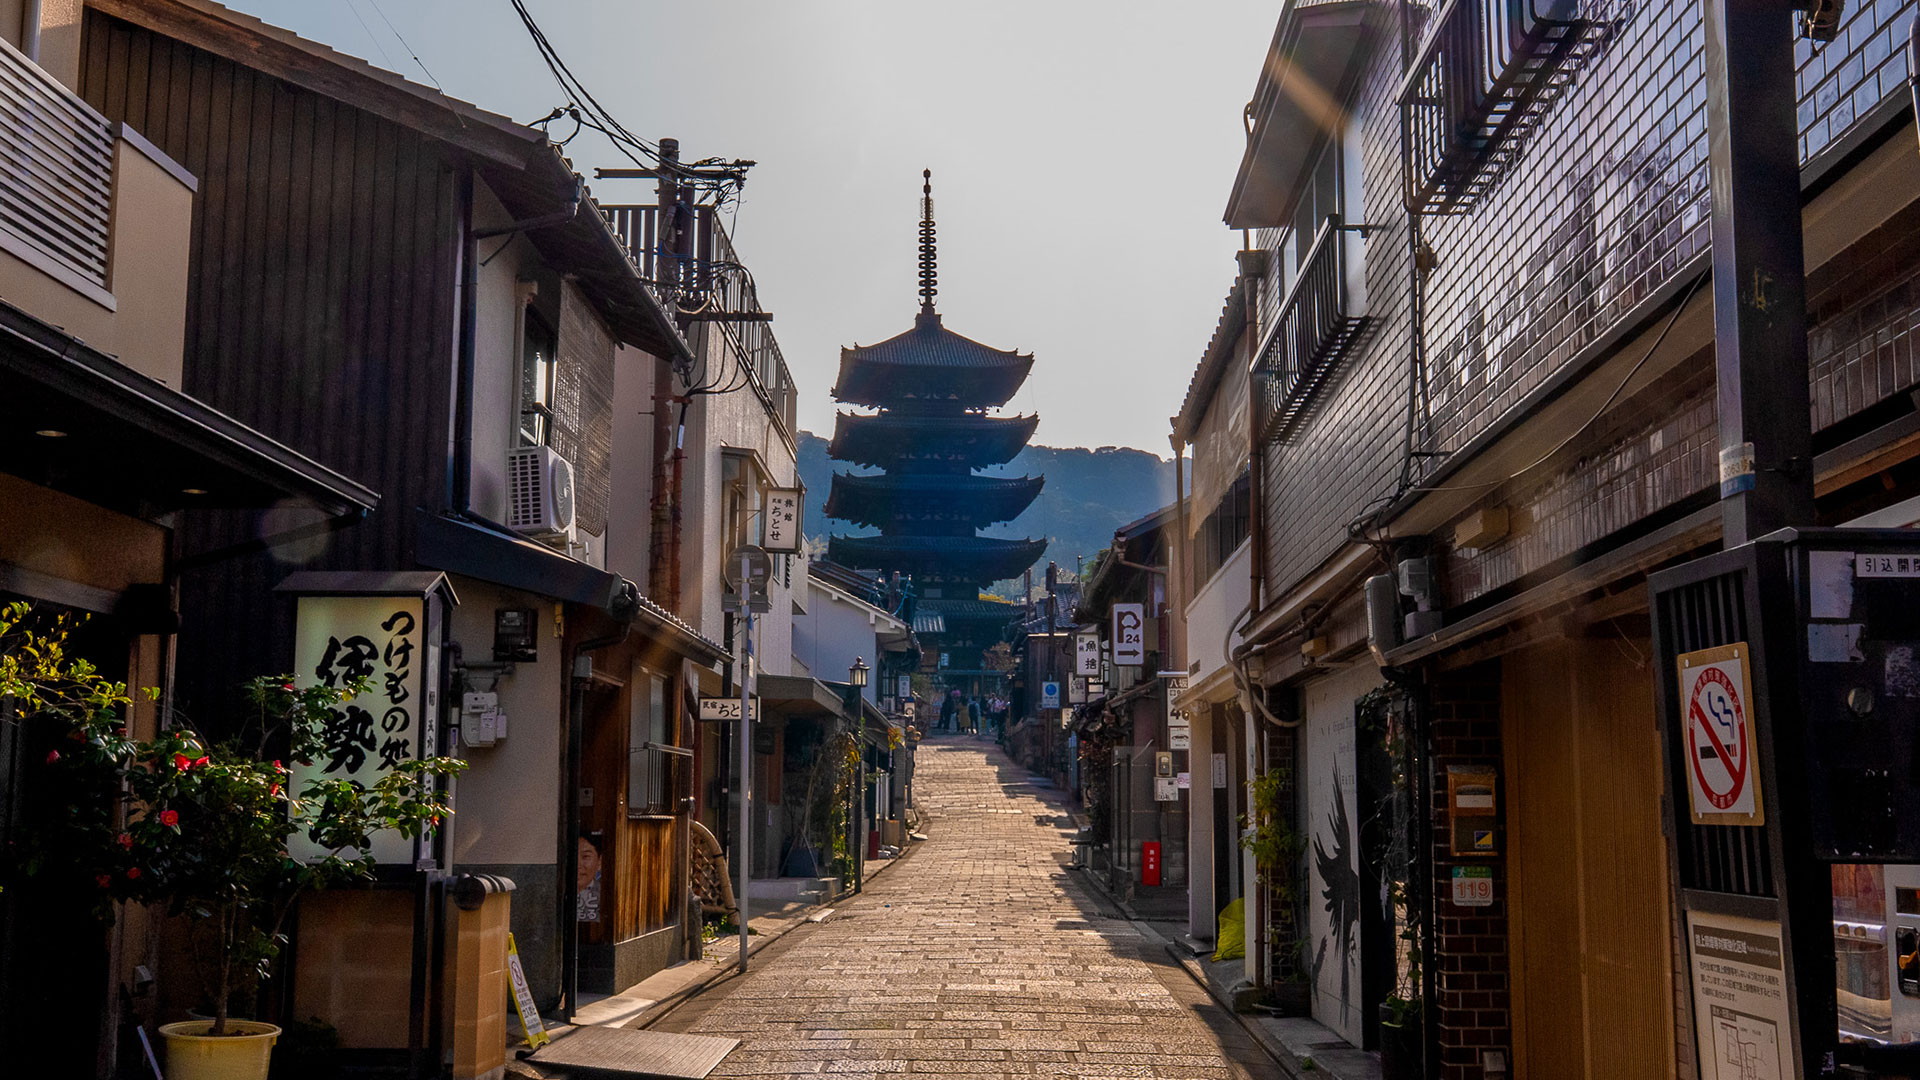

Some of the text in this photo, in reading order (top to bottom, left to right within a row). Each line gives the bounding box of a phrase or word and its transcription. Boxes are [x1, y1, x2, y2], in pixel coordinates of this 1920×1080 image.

[770, 506, 782, 541] ちとせ
[1125, 634, 1140, 644] 24
[376, 611, 415, 773] つけもの処
[309, 635, 379, 850] 伊勢
[1456, 880, 1491, 898] 119
